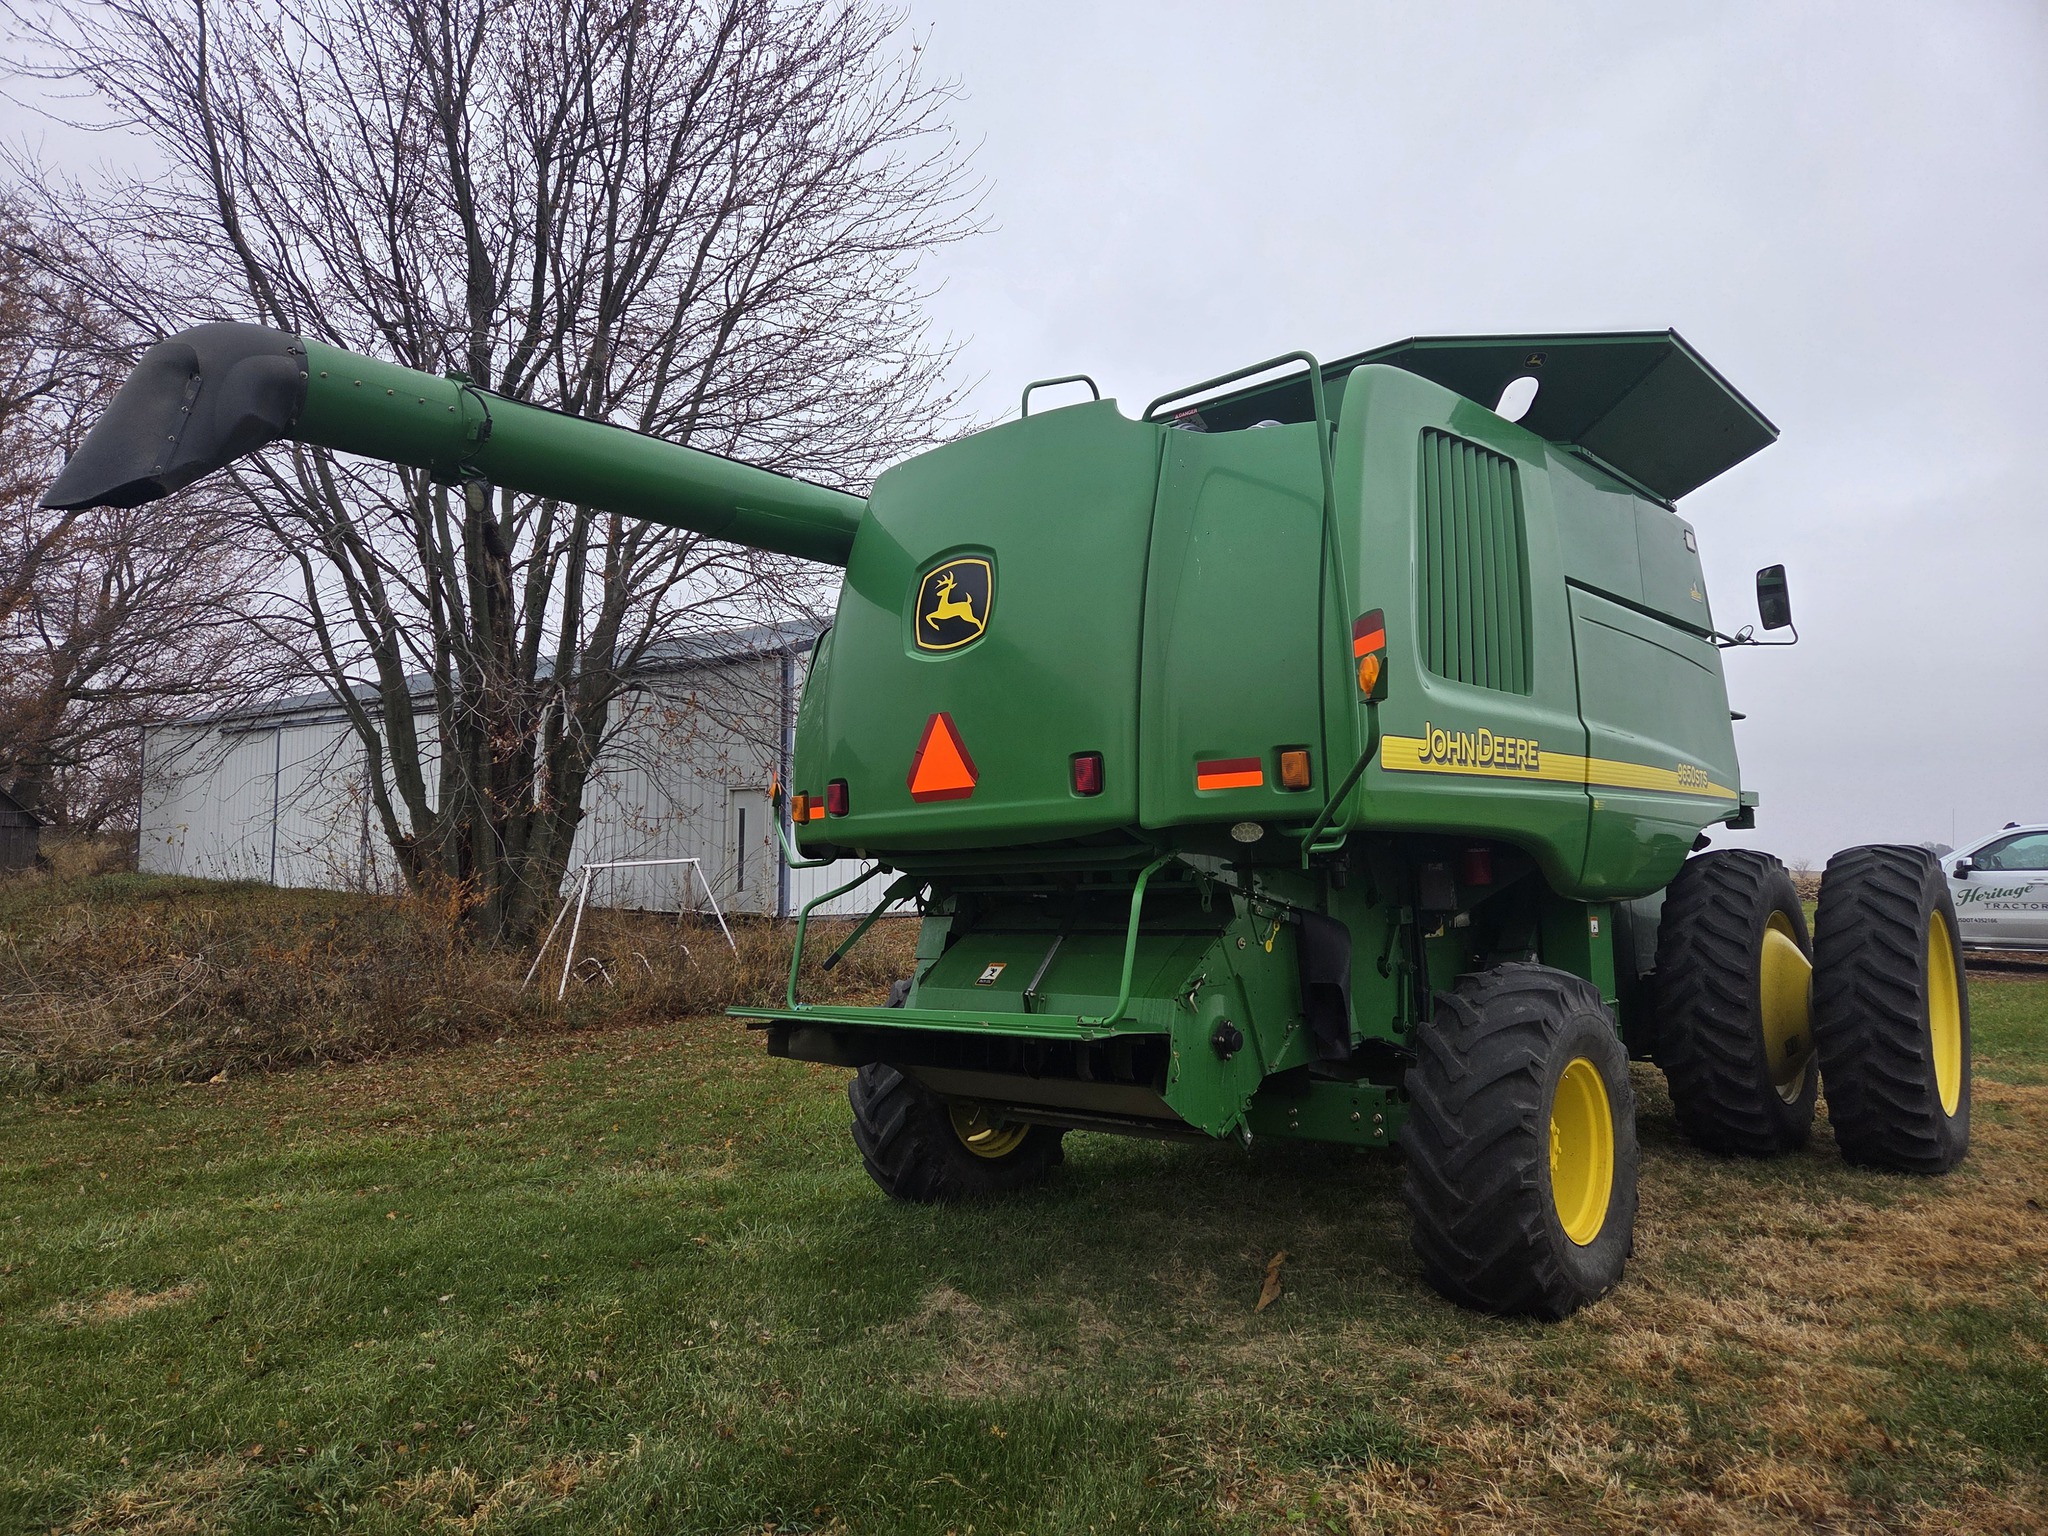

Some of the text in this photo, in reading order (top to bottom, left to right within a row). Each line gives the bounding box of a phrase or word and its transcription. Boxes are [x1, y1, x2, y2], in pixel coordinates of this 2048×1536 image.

[1178, 408, 1198, 418] DANGER
[1418, 721, 1539, 770] JOHN DEERE
[1677, 763, 1708, 787] 9650STS
[1955, 885, 2034, 906] Heritage
